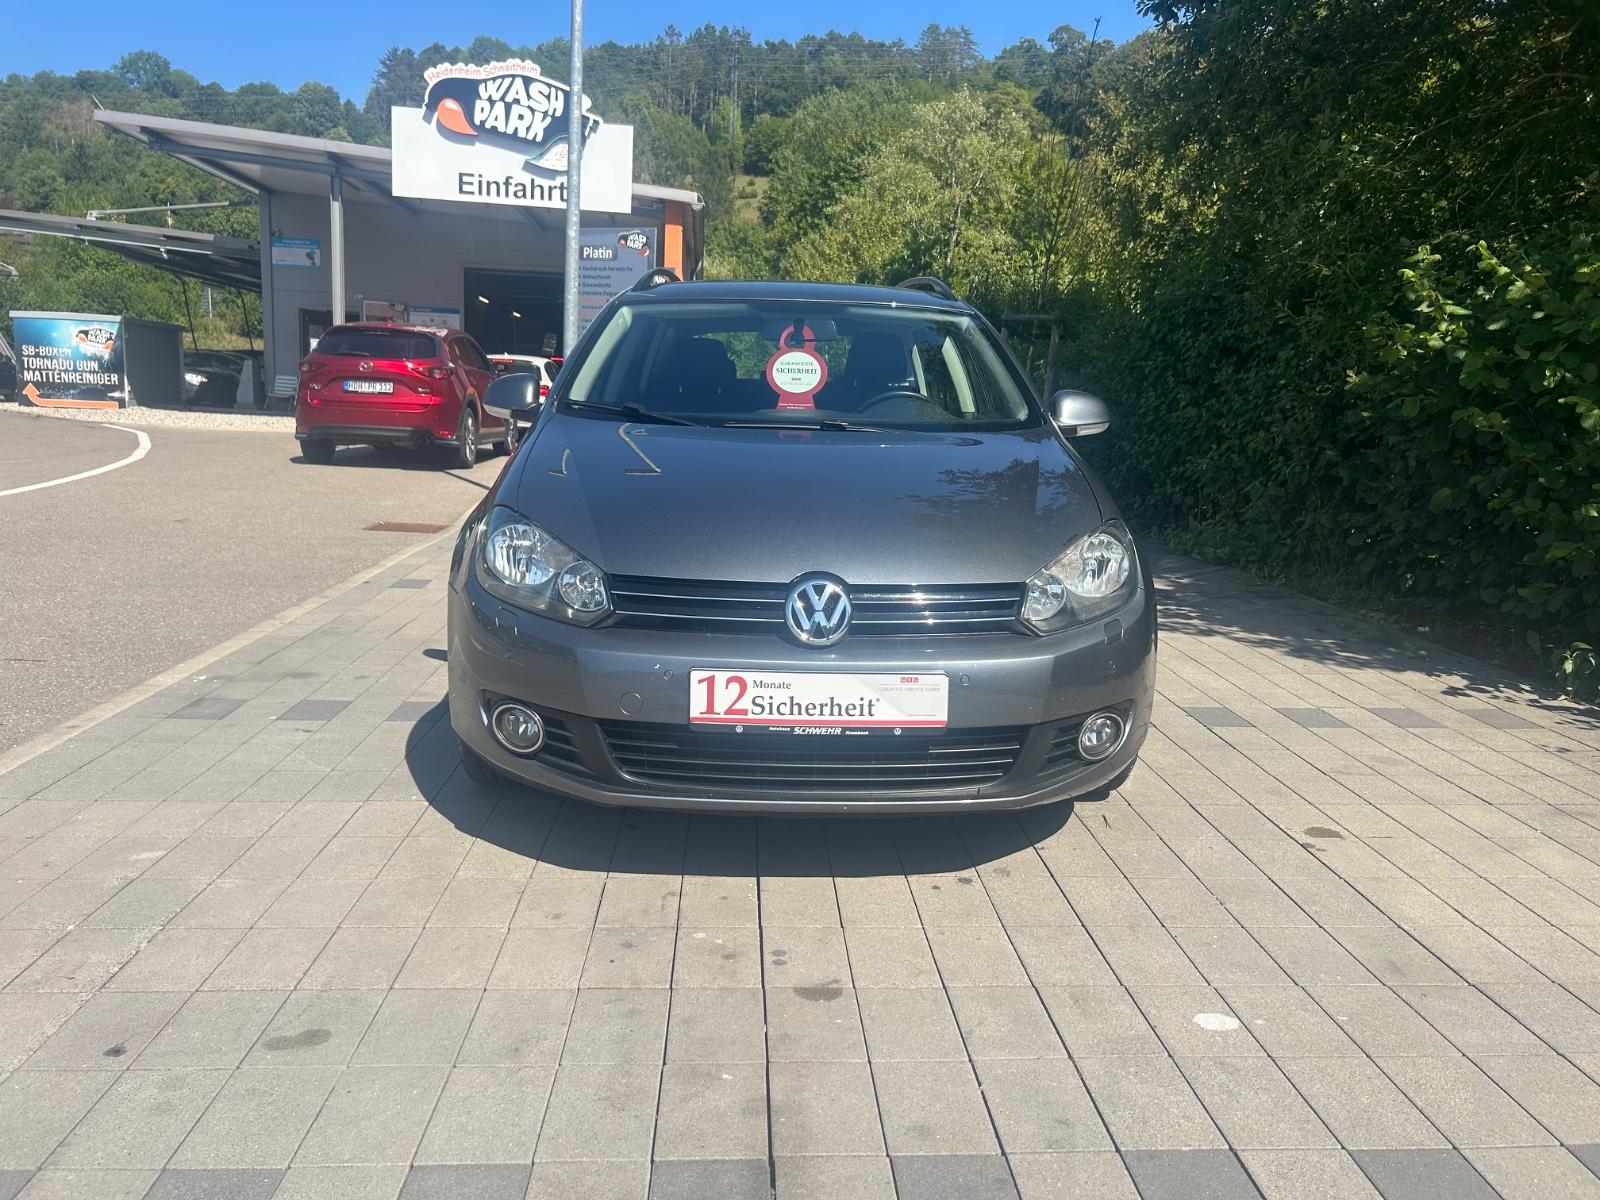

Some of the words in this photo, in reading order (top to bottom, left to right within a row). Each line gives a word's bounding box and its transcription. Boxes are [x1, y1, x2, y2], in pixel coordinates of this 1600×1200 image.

[427, 67, 481, 82] Heidenheim
[483, 62, 538, 77] Schnaitheim
[478, 76, 565, 117] WASH
[473, 99, 552, 142] PARK
[458, 172, 568, 203] Einfahrt
[583, 246, 612, 258] Platin
[22, 357, 73, 370] TORNADO
[23, 370, 118, 385] MATTENREINIGER
[698, 674, 748, 716] 12
[752, 679, 791, 690] Monate
[793, 726, 842, 734] SCHWEHR
